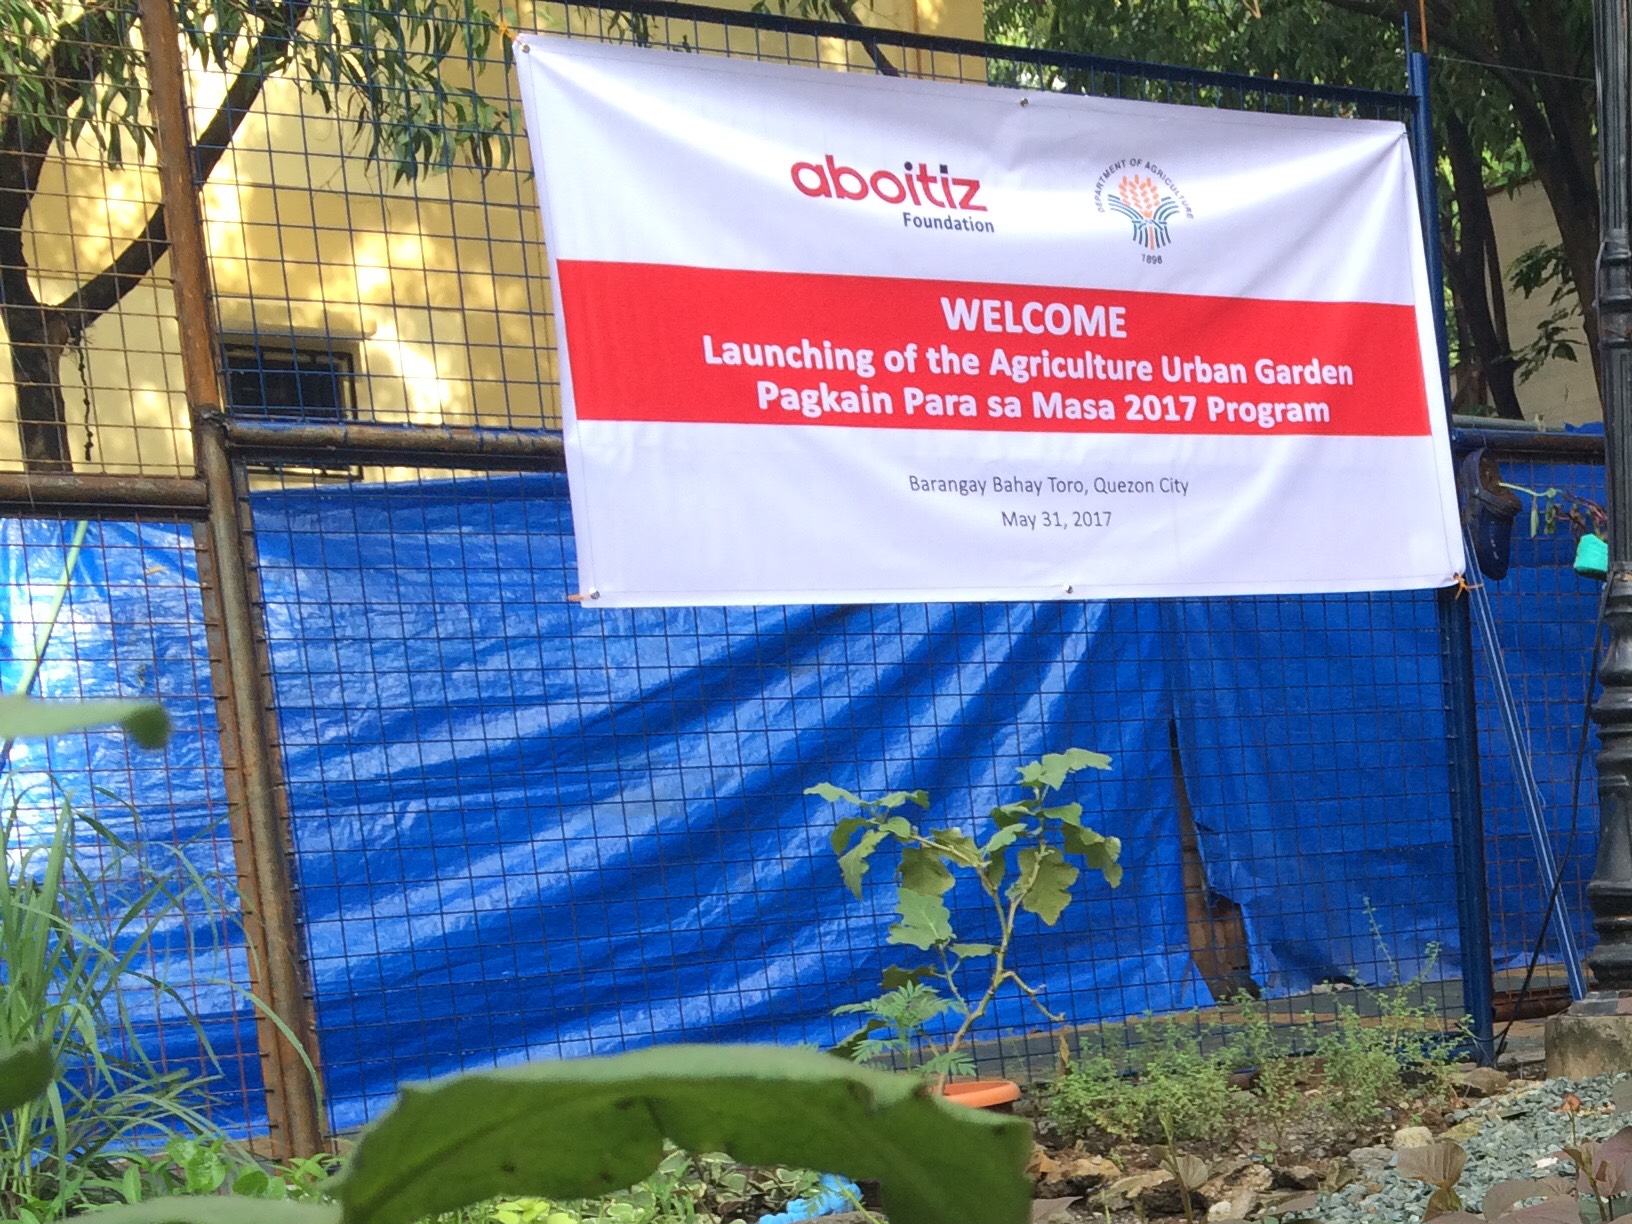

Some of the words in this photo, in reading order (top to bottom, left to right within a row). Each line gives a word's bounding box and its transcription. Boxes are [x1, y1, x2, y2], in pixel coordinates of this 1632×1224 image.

[790, 154, 989, 212] aboitiz
[1093, 159, 1127, 214] DEPARTMENT
[1129, 158, 1143, 168] OF
[1144, 161, 1195, 220] AGRICULTURE
[902, 212, 995, 233] Foundation
[940, 297, 1127, 339] WELCOME
[702, 335, 876, 378] Launching
[884, 343, 918, 373] of
[925, 345, 980, 375] the
[989, 348, 1154, 383] Agriculture
[1160, 355, 1248, 384] Urban
[1254, 358, 1354, 386] Garden
[756, 380, 894, 418] Pagkain
[903, 387, 978, 417] Para
[986, 395, 1022, 418] sa
[1031, 391, 1116, 420] Masa
[1123, 395, 1198, 422] 2017
[1206, 396, 1330, 429] Program
[909, 475, 987, 496] Barangay
[993, 476, 1043, 496] Bahay
[1048, 477, 1089, 496] Toro,
[1093, 477, 1155, 495] Quezon
[1159, 477, 1189, 496] City
[1001, 511, 1036, 530] May
[1042, 511, 1068, 529] 31,
[1073, 511, 1112, 527] 2017
